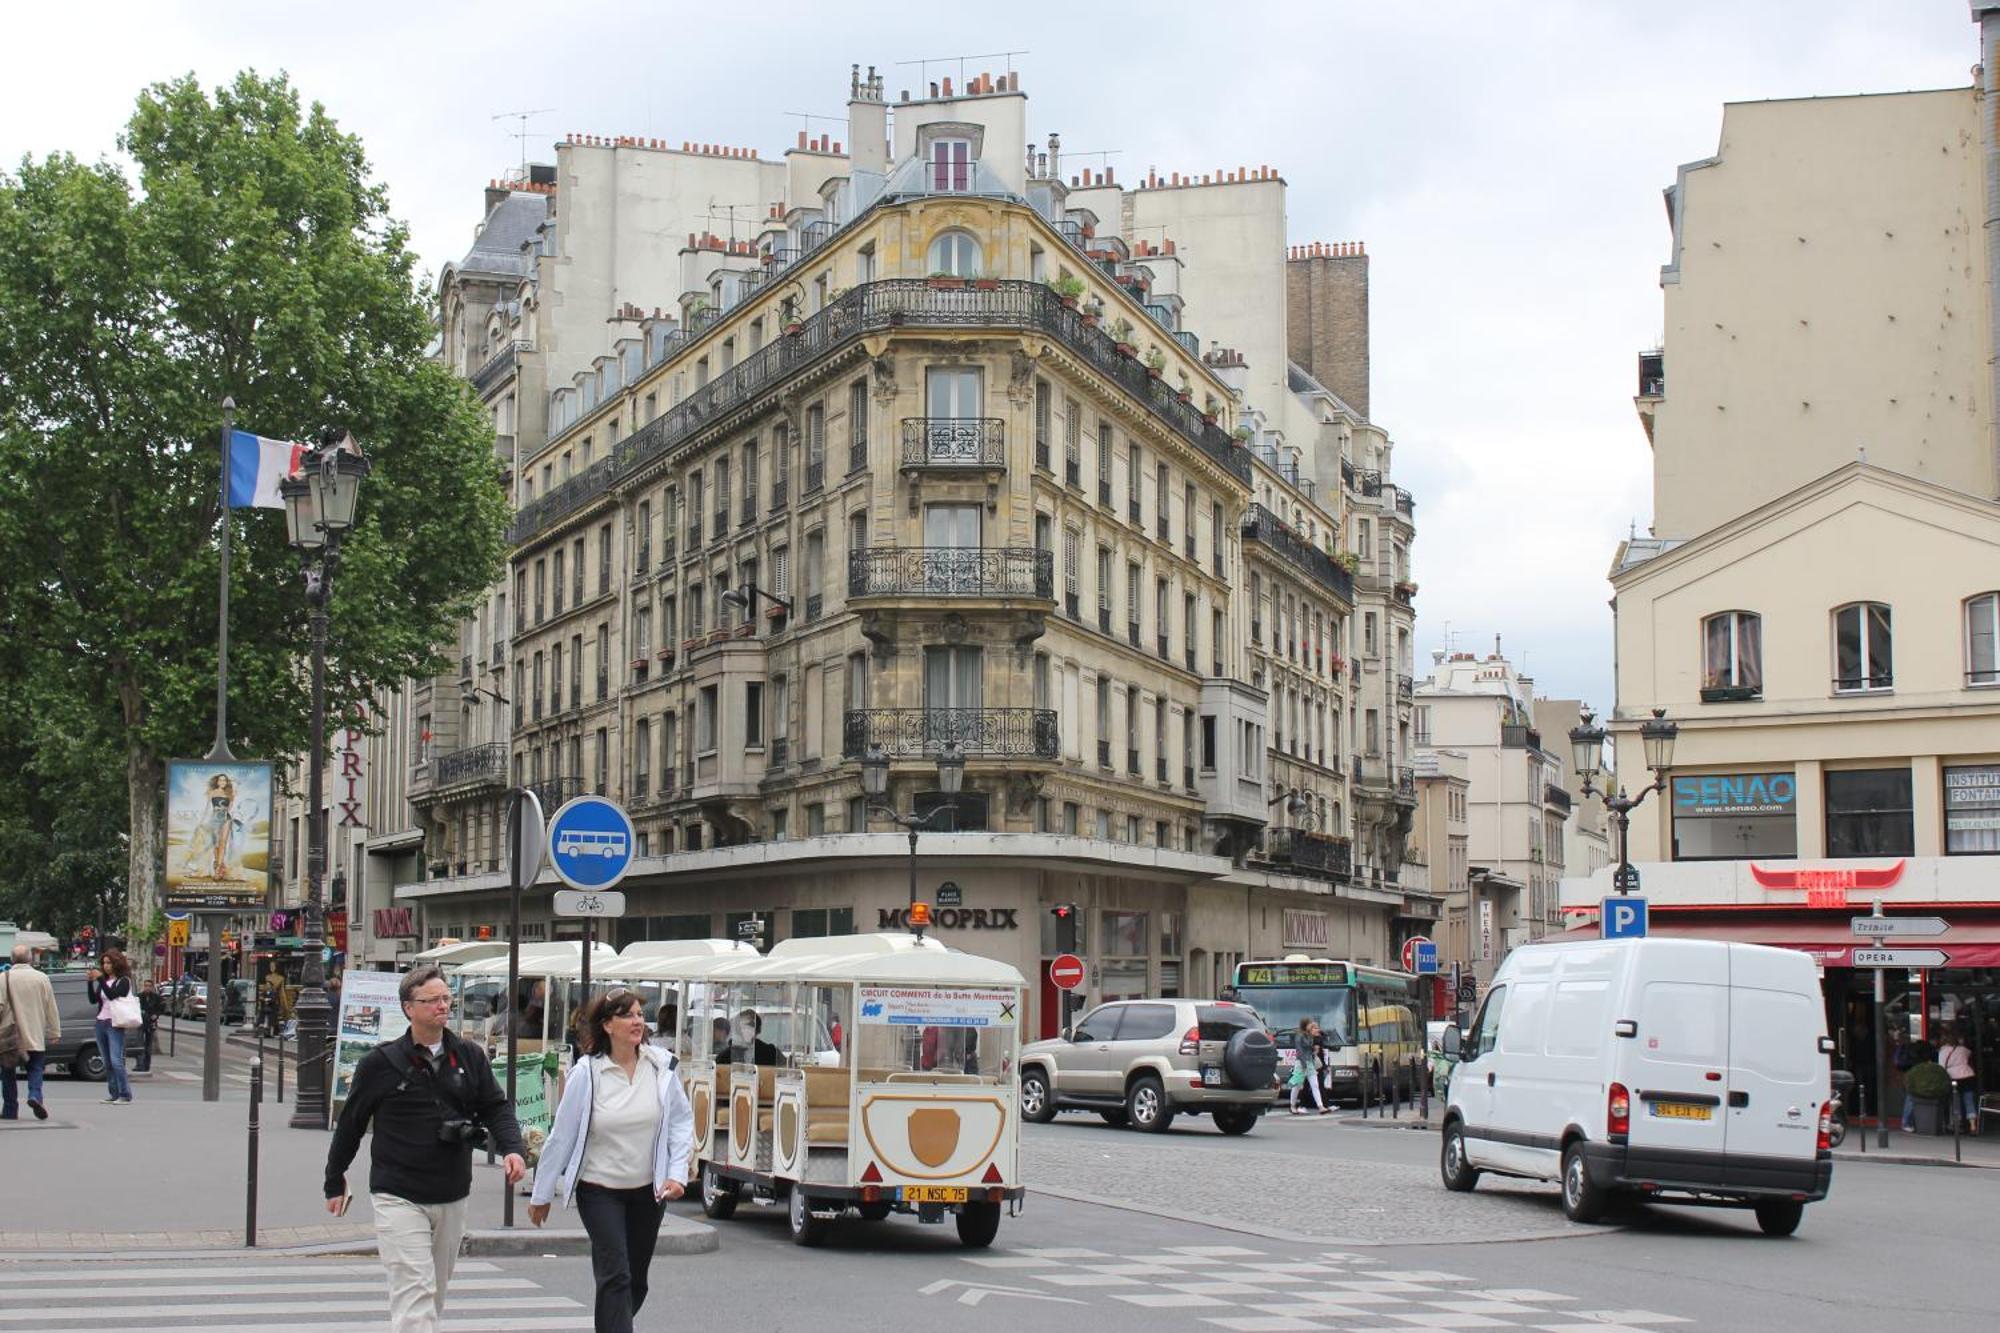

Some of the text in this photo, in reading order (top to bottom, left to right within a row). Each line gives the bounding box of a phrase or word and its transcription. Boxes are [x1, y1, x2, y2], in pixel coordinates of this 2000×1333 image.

[1696, 804, 1782, 813] www.senao.com
[877, 908, 1018, 930] MONOPRIX
[1616, 906, 1635, 932] P
[1858, 954, 1893, 962] OPERA
[1253, 970, 1270, 982] 74
[861, 989, 888, 997] CIRCUIT
[933, 991, 943, 999] de
[944, 992, 952, 1000] la
[953, 992, 971, 1000] Butte
[908, 1187, 965, 1201] 21 NSC 75
